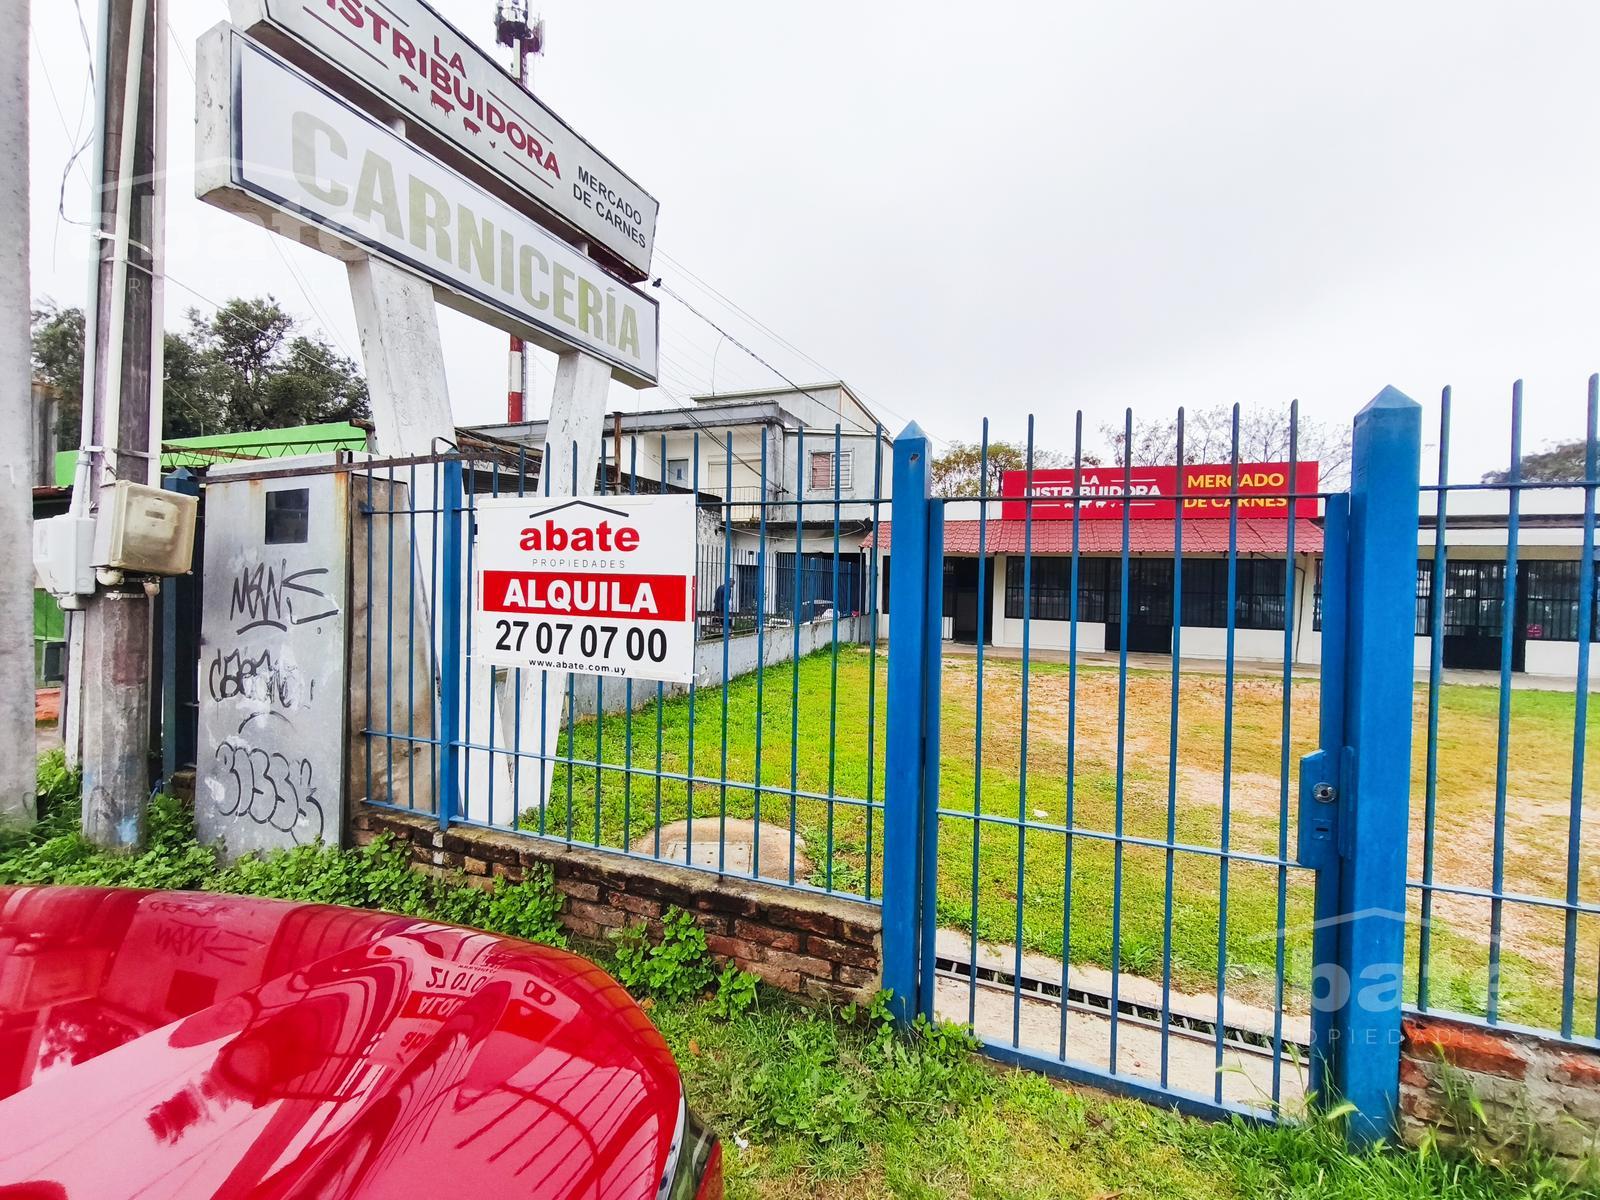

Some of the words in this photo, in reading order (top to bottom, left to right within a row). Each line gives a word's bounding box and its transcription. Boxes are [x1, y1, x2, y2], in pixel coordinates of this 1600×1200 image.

[433, 35, 467, 79] LA
[578, 165, 642, 225] MERCADO
[573, 183, 592, 209] DE
[595, 201, 646, 249] CARNES
[291, 110, 642, 360] CARNICERÍA
[1023, 485, 1161, 497] DISTRBUIDORA
[1081, 475, 1099, 485] LA
[519, 519, 640, 552] abate
[532, 558, 626, 569] PROPIEDADES
[502, 578, 659, 615] ALQUILA
[495, 619, 529, 652] 27
[536, 621, 573, 655] 07
[580, 624, 618, 659] 07
[626, 627, 667, 663] 00
[528, 659, 627, 676] www.abate.com.uy
